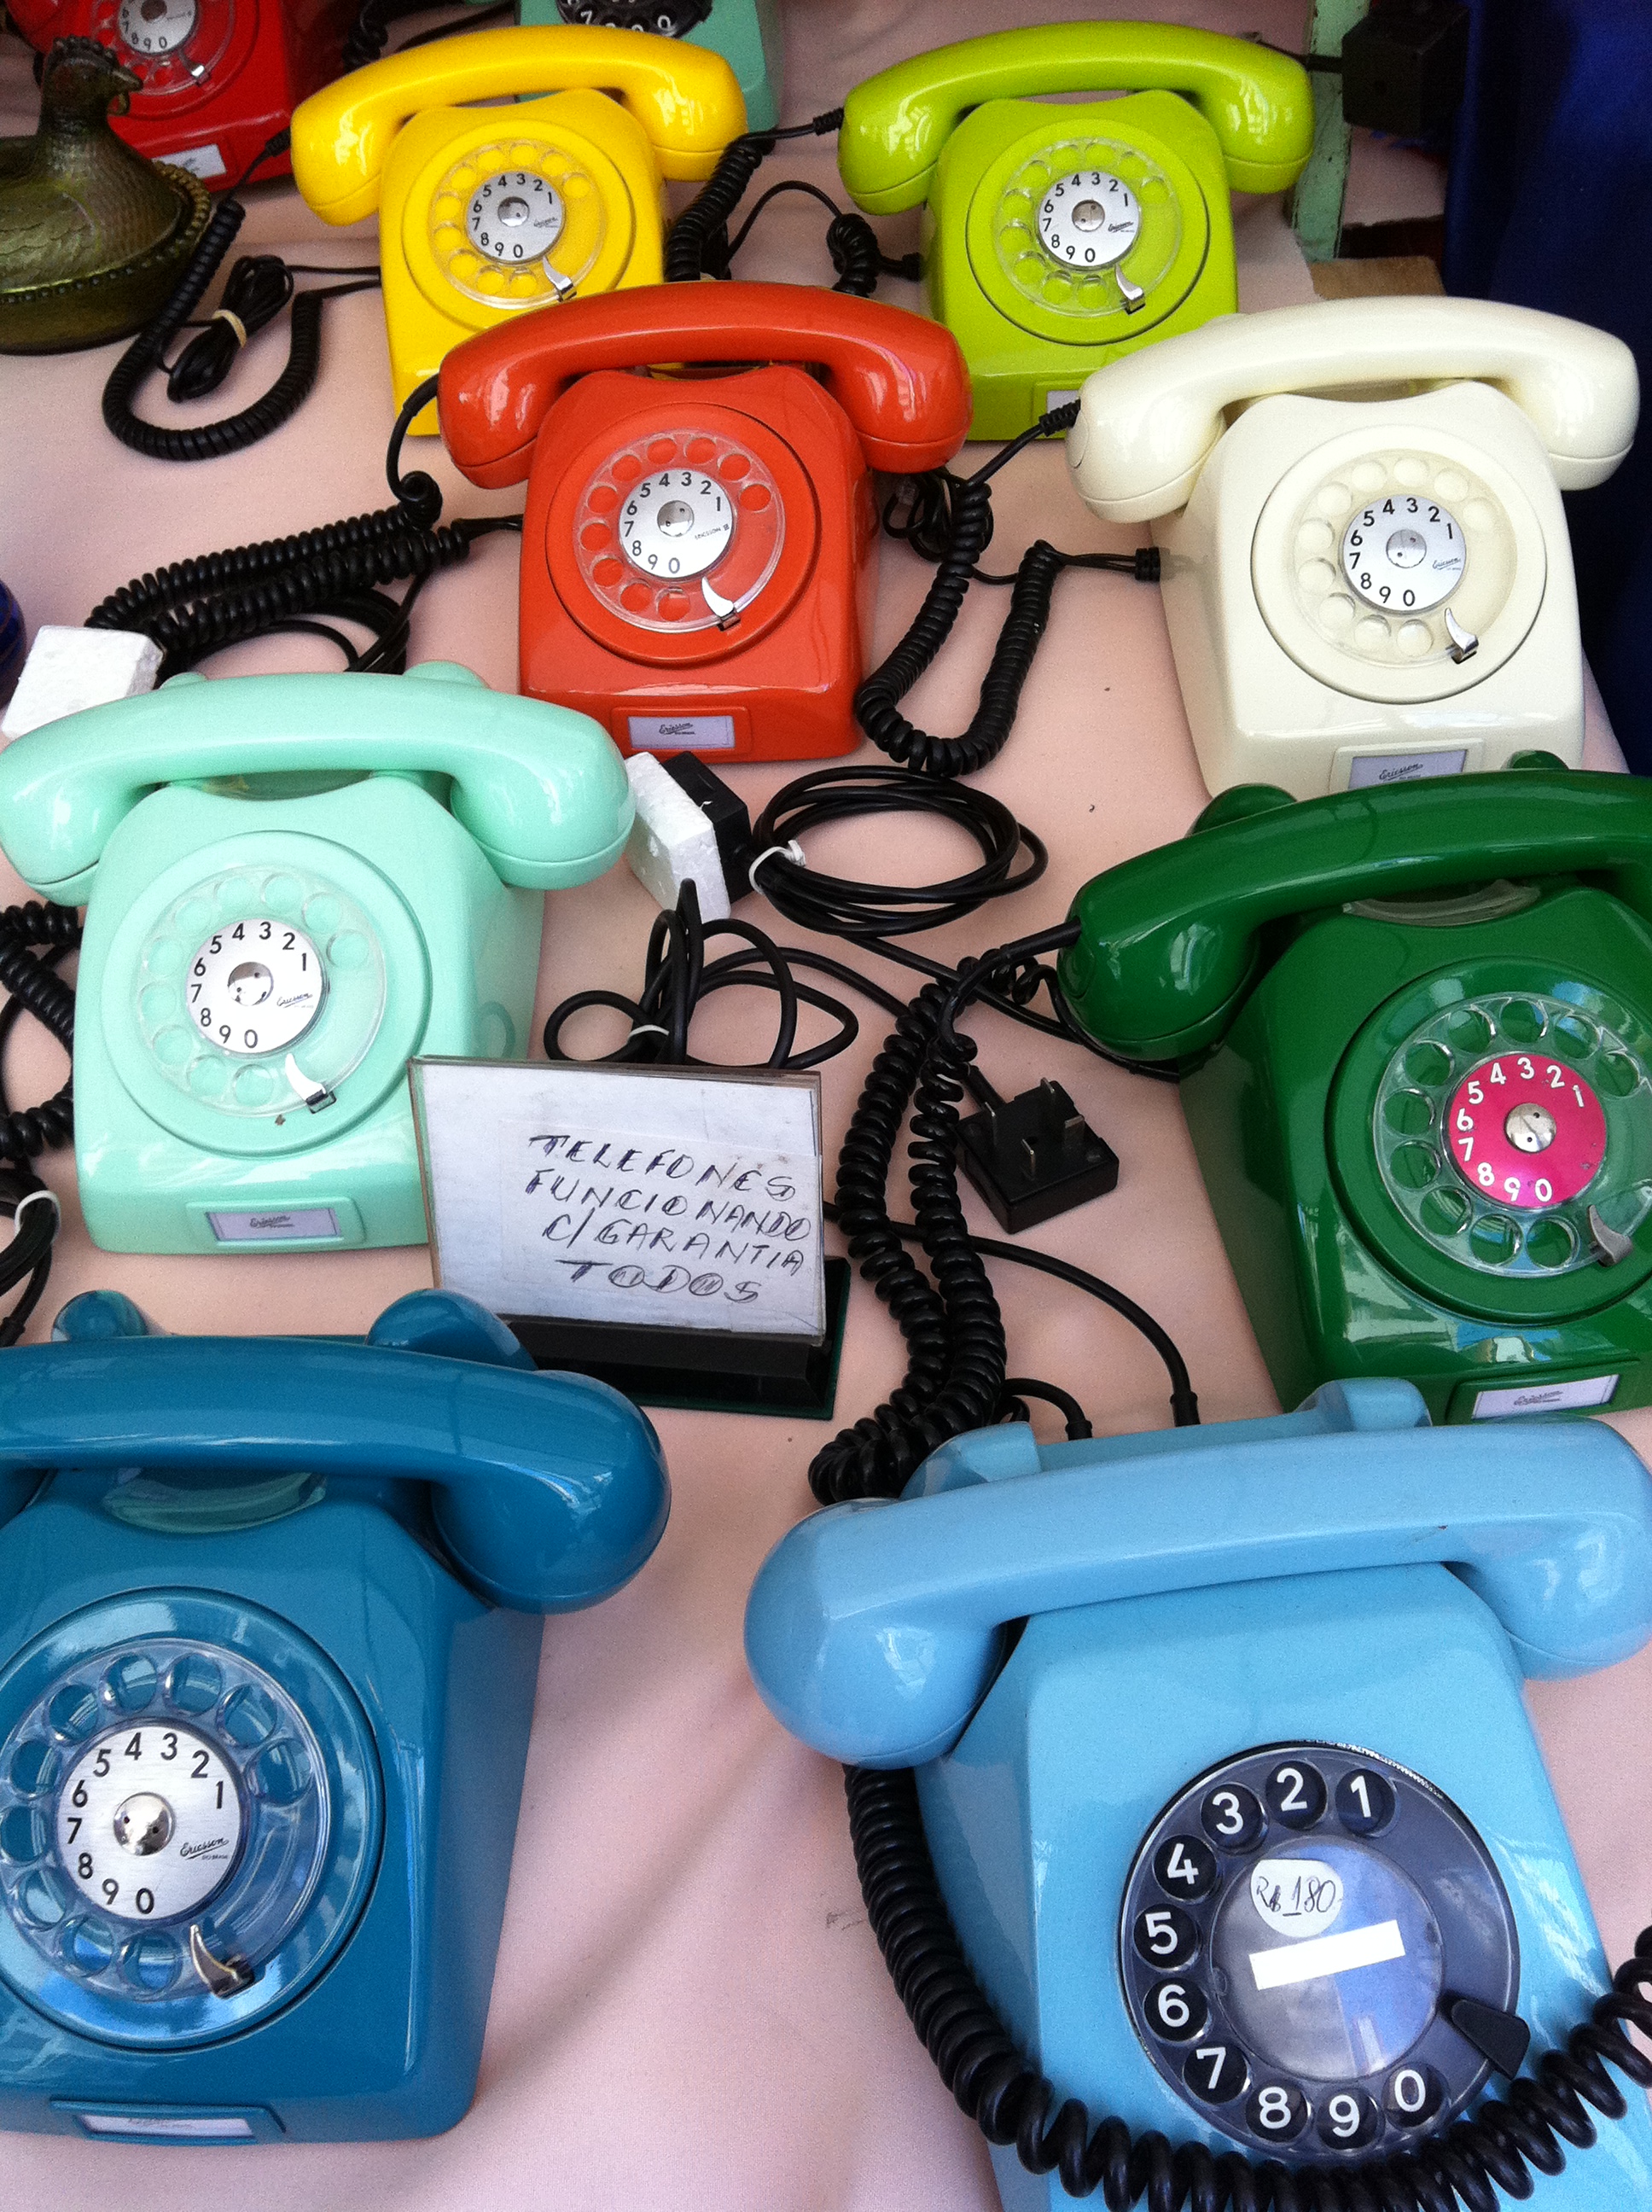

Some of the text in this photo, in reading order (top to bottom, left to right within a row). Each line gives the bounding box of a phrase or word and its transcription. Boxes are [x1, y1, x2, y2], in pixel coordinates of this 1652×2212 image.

[121, 20, 130, 33] 7
[143, 37, 152, 50] 9
[158, 36, 168, 49] 0
[580, 9, 593, 25] 7
[656, 15, 672, 30] 0
[471, 172, 553, 259] 1 2 3 4 5 6 7 8 9 0
[1042, 171, 1129, 264] 1 2 3 4 5 6 7 8 9 0
[623, 471, 721, 574] 1 2 3 4 5 6 7 8 9 0
[1348, 497, 1453, 608] 1 2 3 4 5 6 7 8 9 0
[190, 921, 307, 1049] 1 2 3 4 5 6 7 8 9 0
[528, 1134, 796, 1202] TELEFONES
[1457, 1057, 1584, 1202] 1 2 3 4 5 6 7 8 9 0
[524, 1168, 811, 1241] FUNCIONANDO
[554, 1259, 762, 1304] TODOS
[67, 1732, 224, 1914] 1 2 3 4 5 6 7 8 9 0
[179, 1837, 230, 1860] Ericsson
[1145, 1768, 1425, 2137] 1 2 3 4 5 6 7 8 9 0
